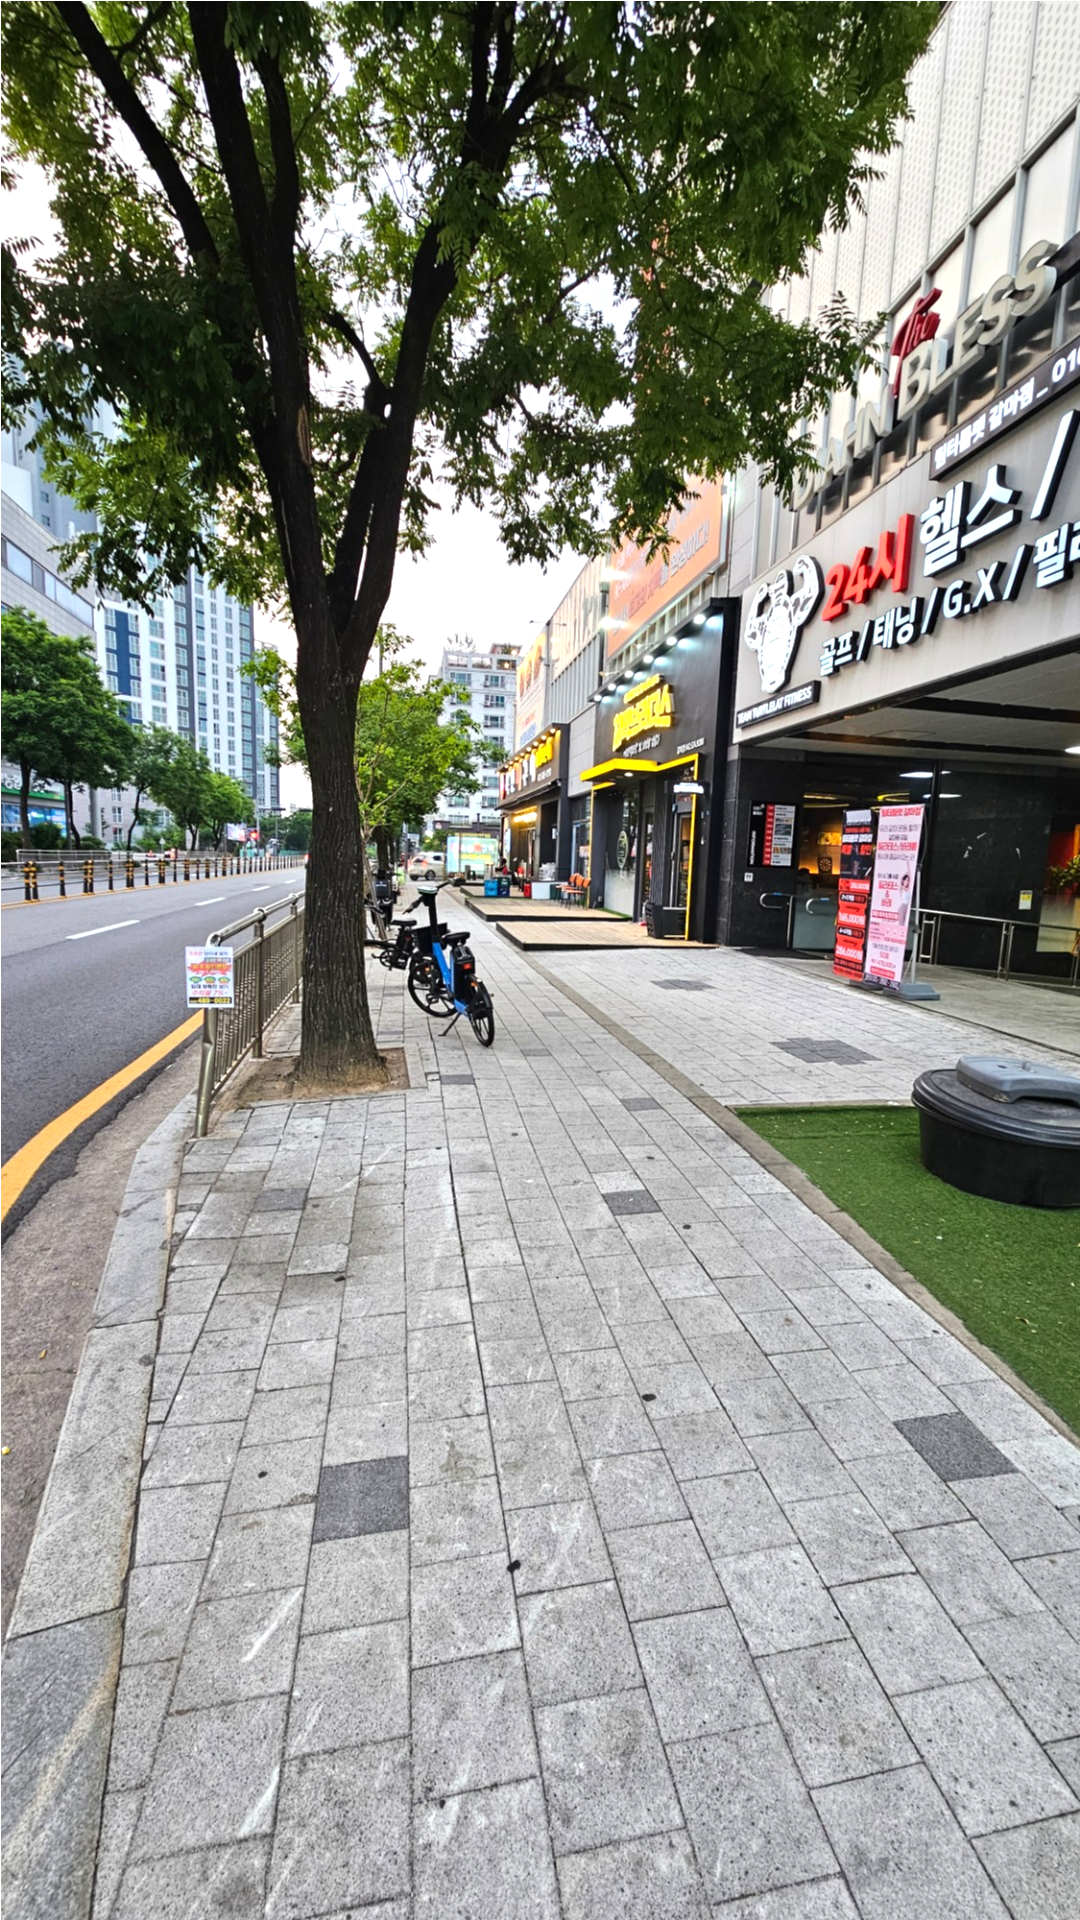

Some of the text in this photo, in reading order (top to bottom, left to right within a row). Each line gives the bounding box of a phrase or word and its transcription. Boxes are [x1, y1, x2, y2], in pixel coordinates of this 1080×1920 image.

[891, 288, 943, 397] The
[897, 240, 1059, 422] BLESS
[988, 377, 1035, 431] 갈마점
[822, 514, 915, 622] 24시
[784, 685, 812, 708] FITNESS
